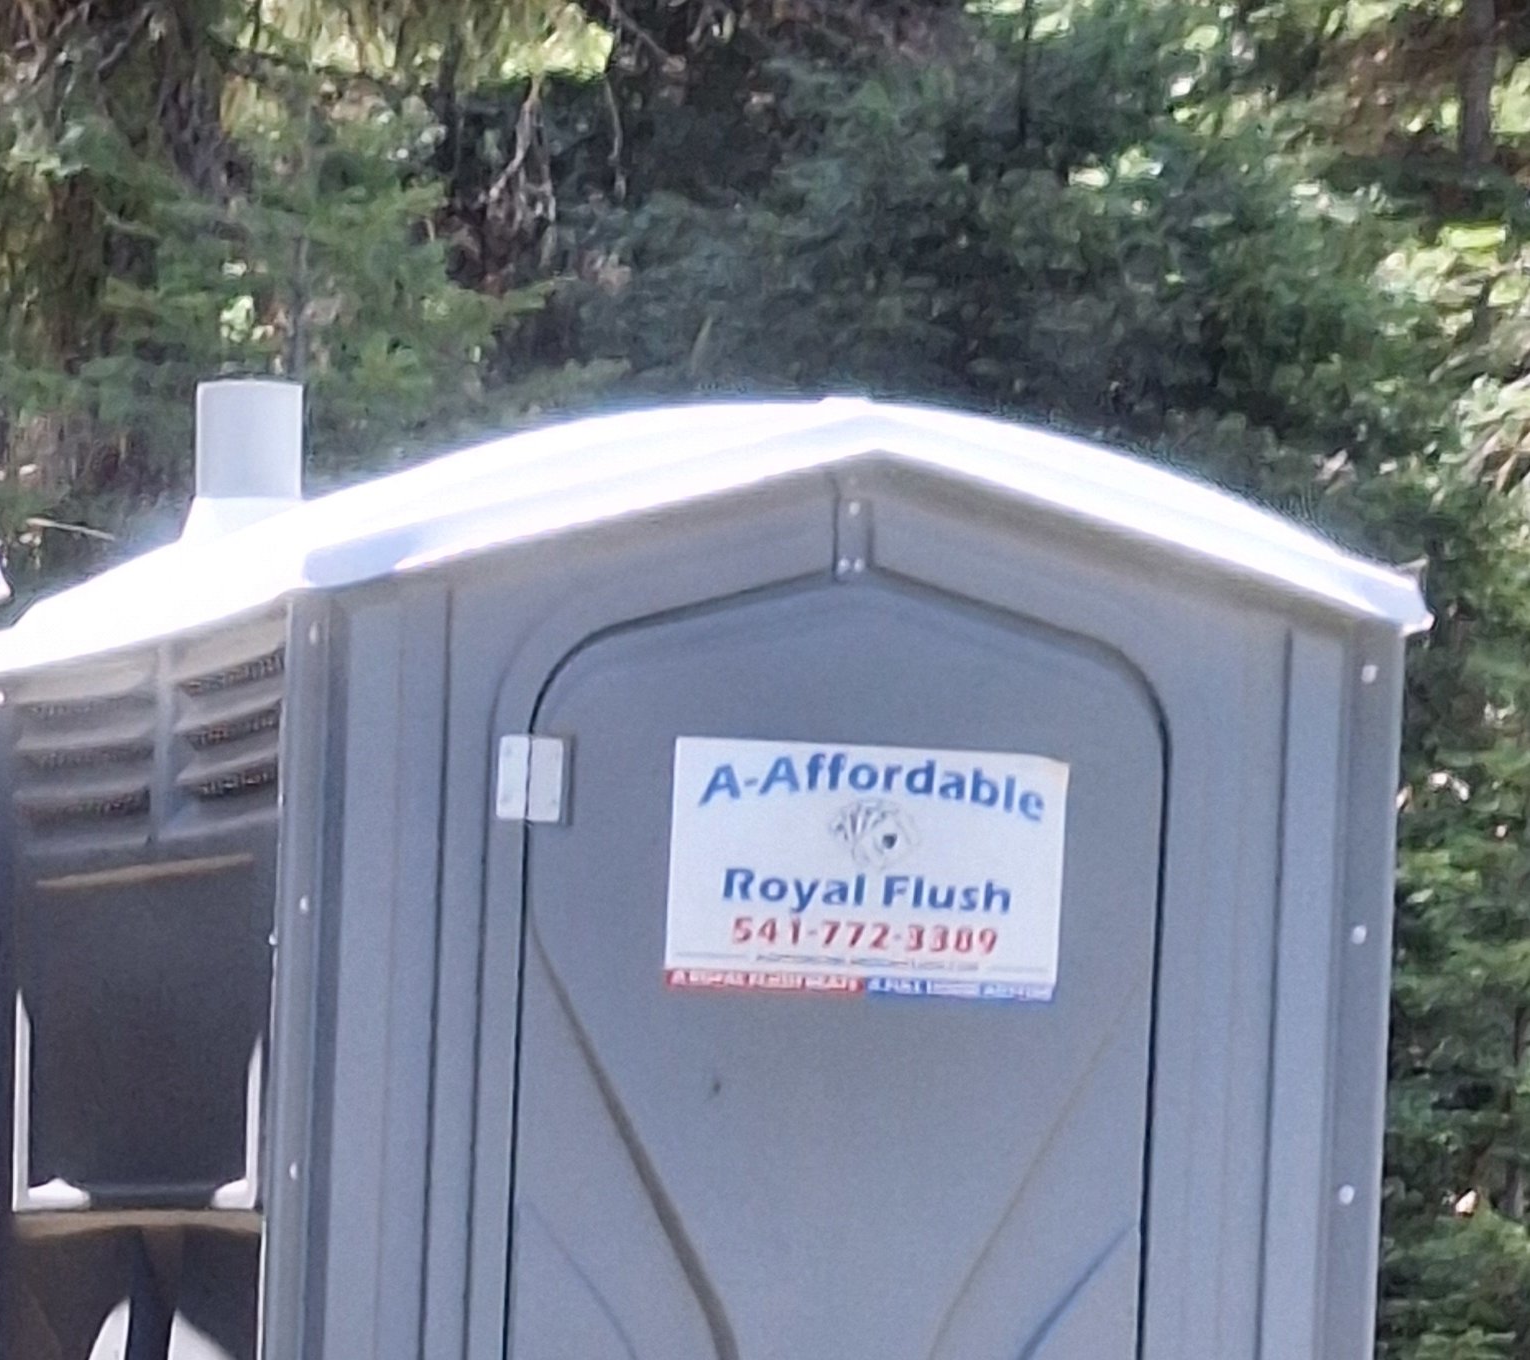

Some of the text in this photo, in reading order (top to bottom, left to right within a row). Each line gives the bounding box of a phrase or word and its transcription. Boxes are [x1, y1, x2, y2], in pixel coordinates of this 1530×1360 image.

[698, 752, 1046, 823] A-Affordable
[722, 867, 1012, 915] Royal Flush
